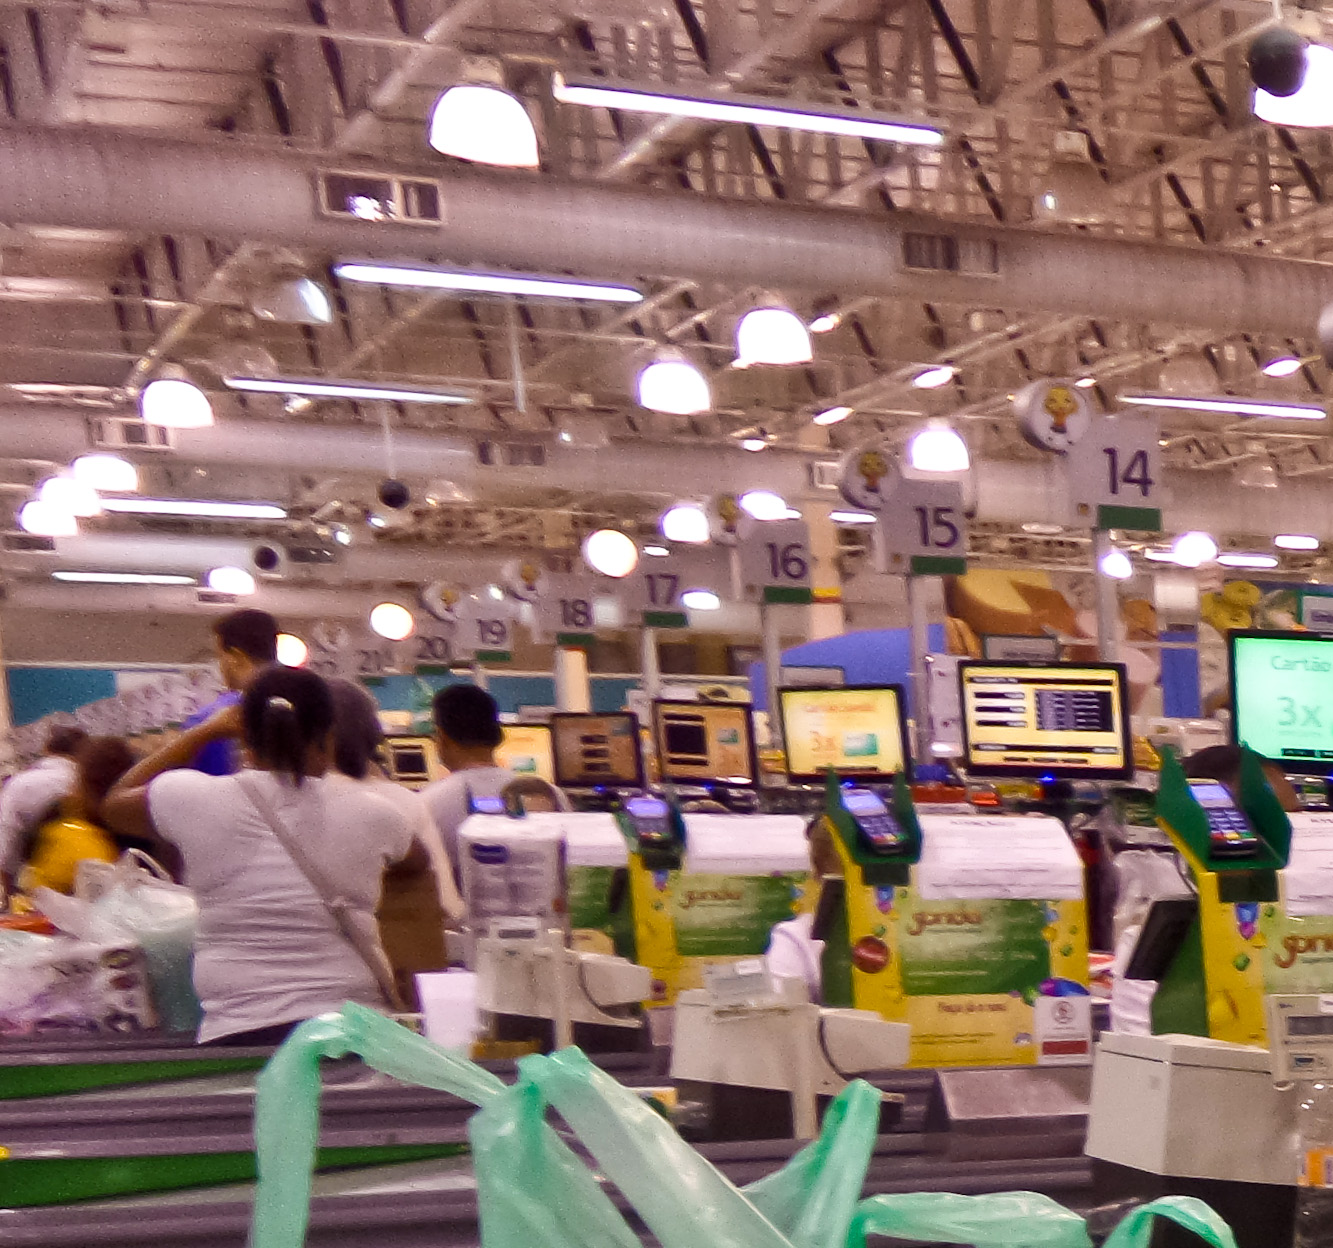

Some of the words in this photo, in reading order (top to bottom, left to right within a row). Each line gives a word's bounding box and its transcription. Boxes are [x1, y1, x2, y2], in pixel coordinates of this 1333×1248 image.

[1102, 446, 1154, 497] 14
[915, 506, 960, 549] 15
[768, 542, 808, 580] 16
[646, 573, 679, 605] 17
[561, 599, 594, 628] 18
[415, 636, 449, 659] 20
[478, 618, 507, 645] 19
[1271, 655, 1331, 673] Cartão
[1276, 696, 1323, 729] 3x
